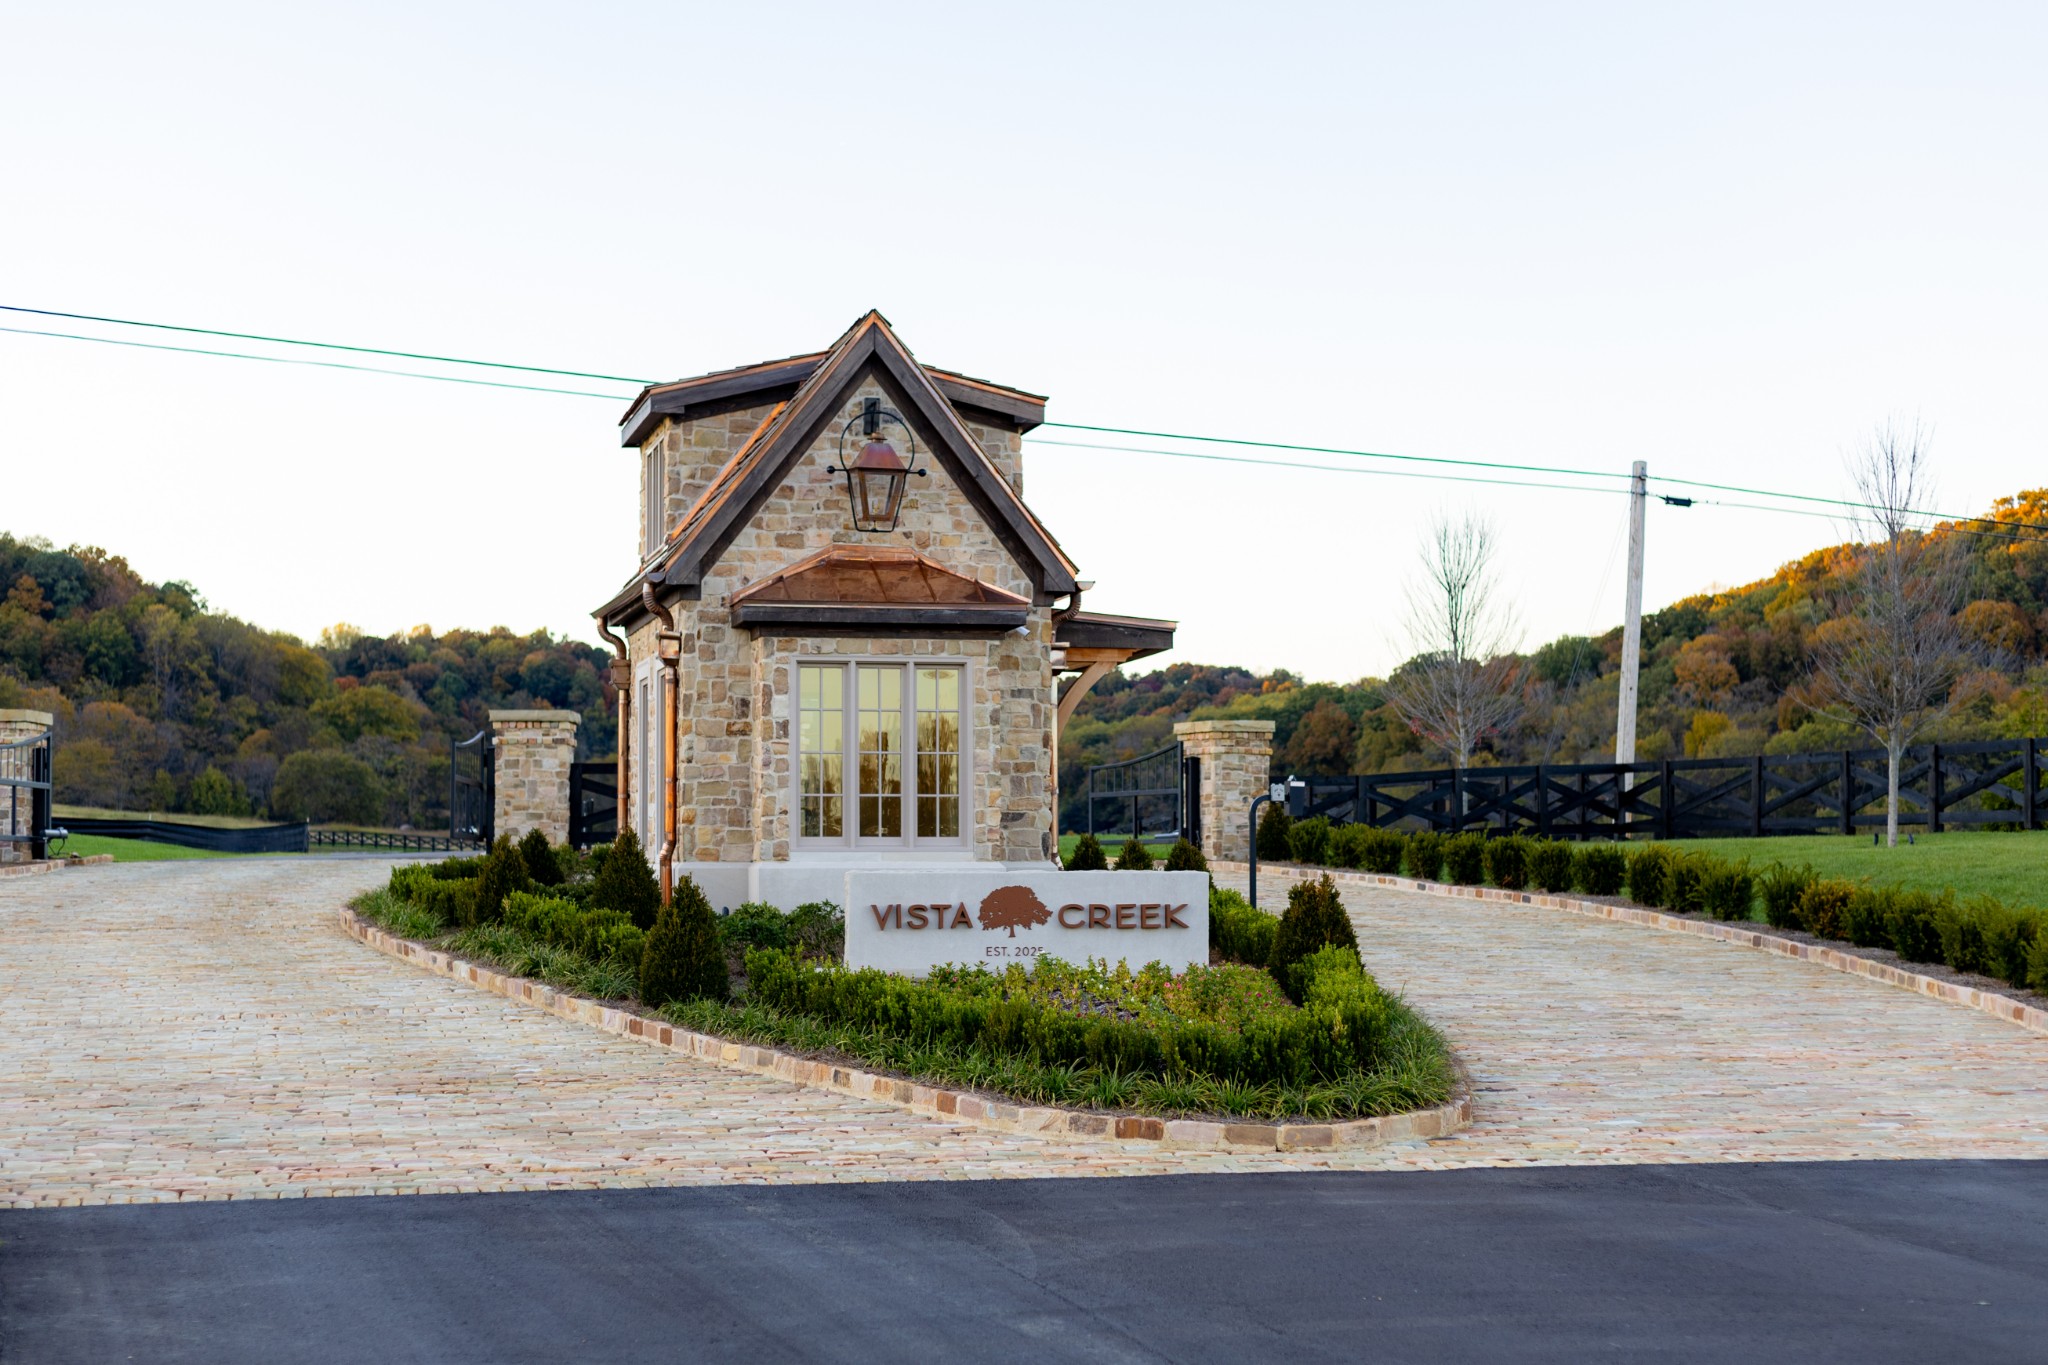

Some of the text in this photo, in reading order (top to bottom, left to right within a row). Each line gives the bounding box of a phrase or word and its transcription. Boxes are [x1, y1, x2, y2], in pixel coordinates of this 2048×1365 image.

[871, 902, 1190, 931] VISTA CREEK
[986, 946, 1010, 957] EST.
